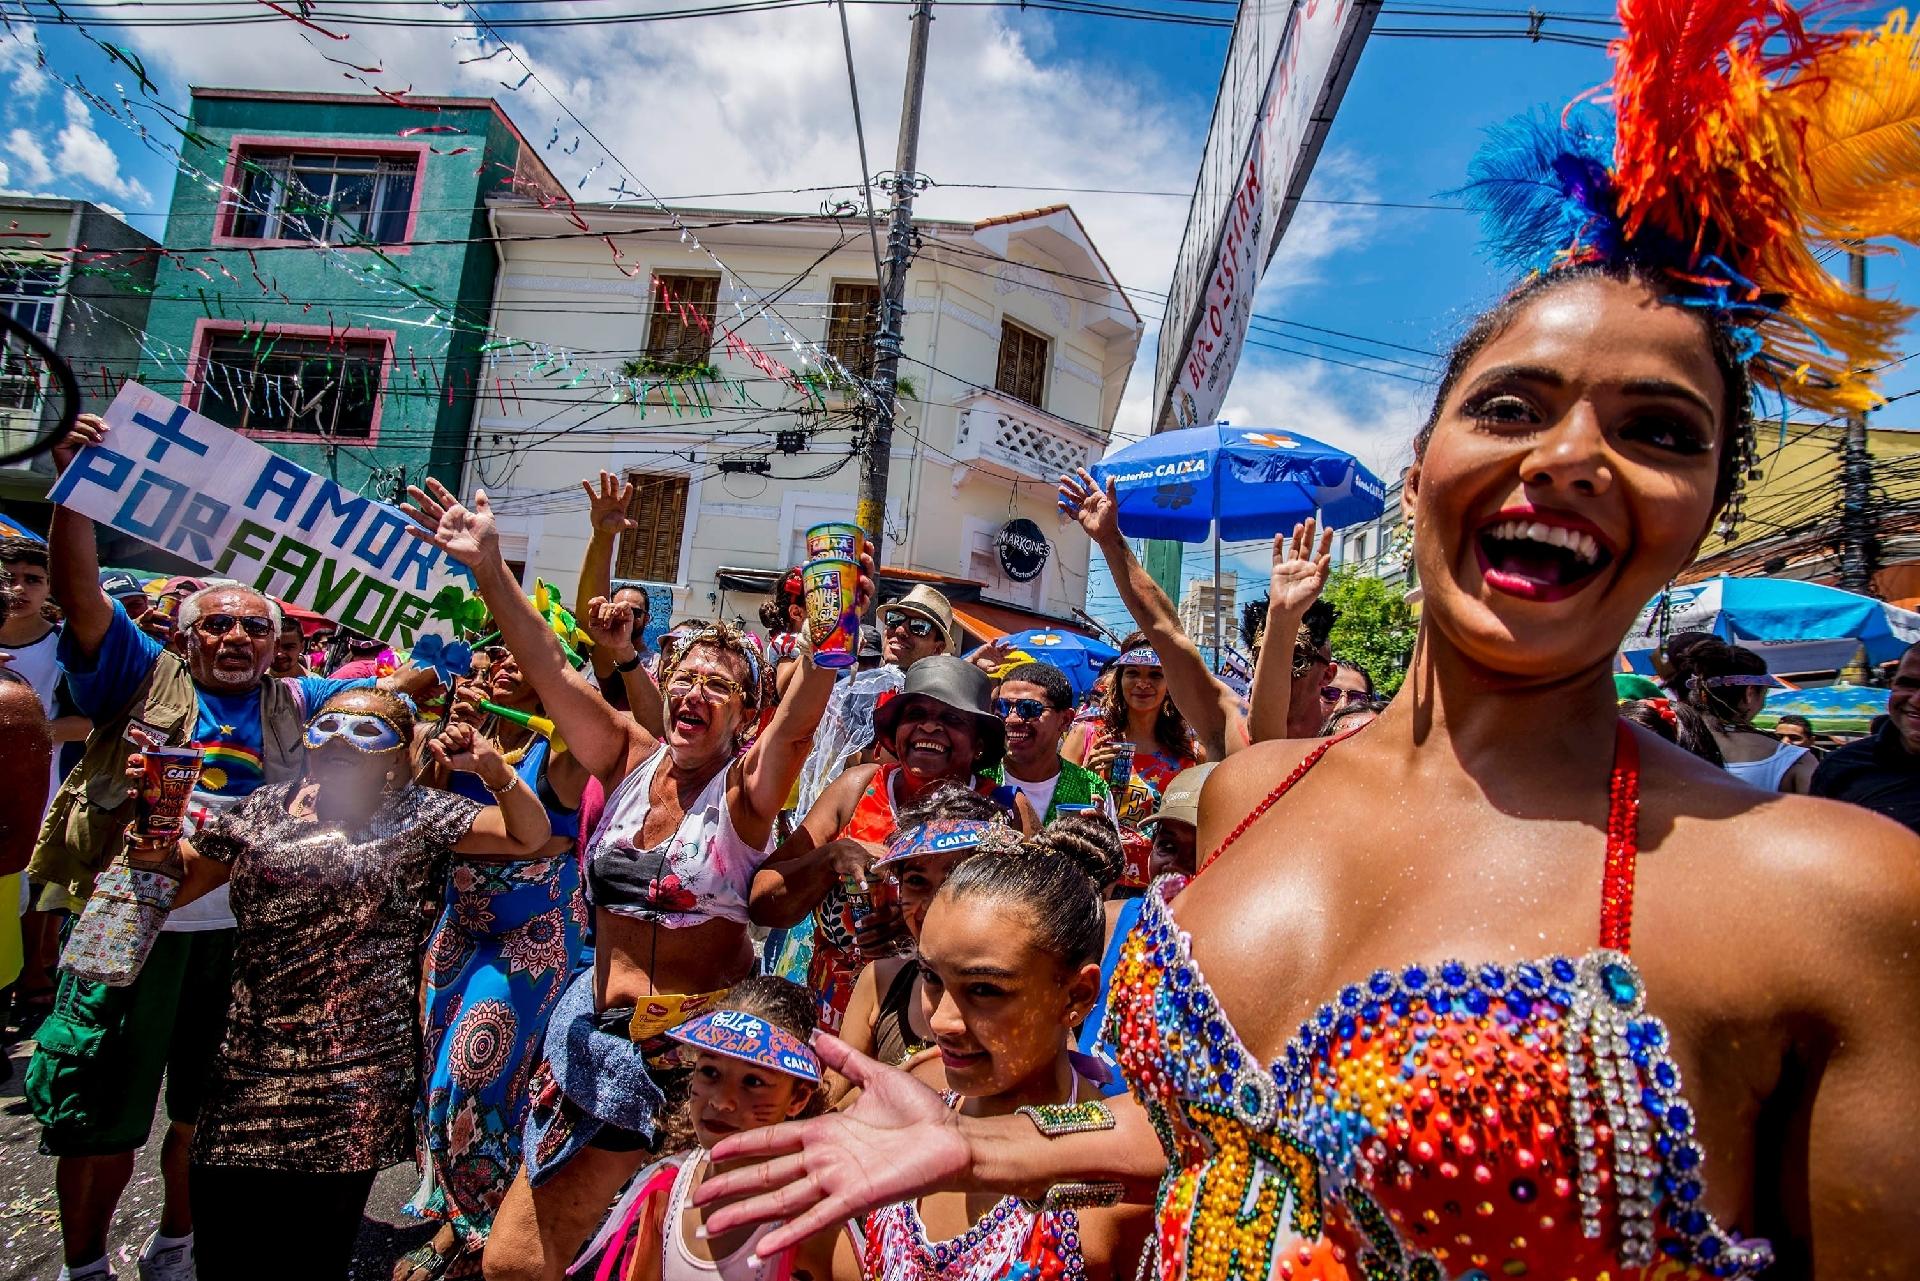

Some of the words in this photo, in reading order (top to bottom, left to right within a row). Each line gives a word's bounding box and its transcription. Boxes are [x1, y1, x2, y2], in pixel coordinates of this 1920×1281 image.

[1155, 459, 1205, 477] CAIXA
[244, 455, 442, 591] AMOR
[51, 445, 231, 562] POR
[214, 518, 432, 650] FAVOR
[996, 530, 1051, 557] MARKONES
[936, 832, 980, 848] CAIXA
[783, 1056, 816, 1076] CAIXA
